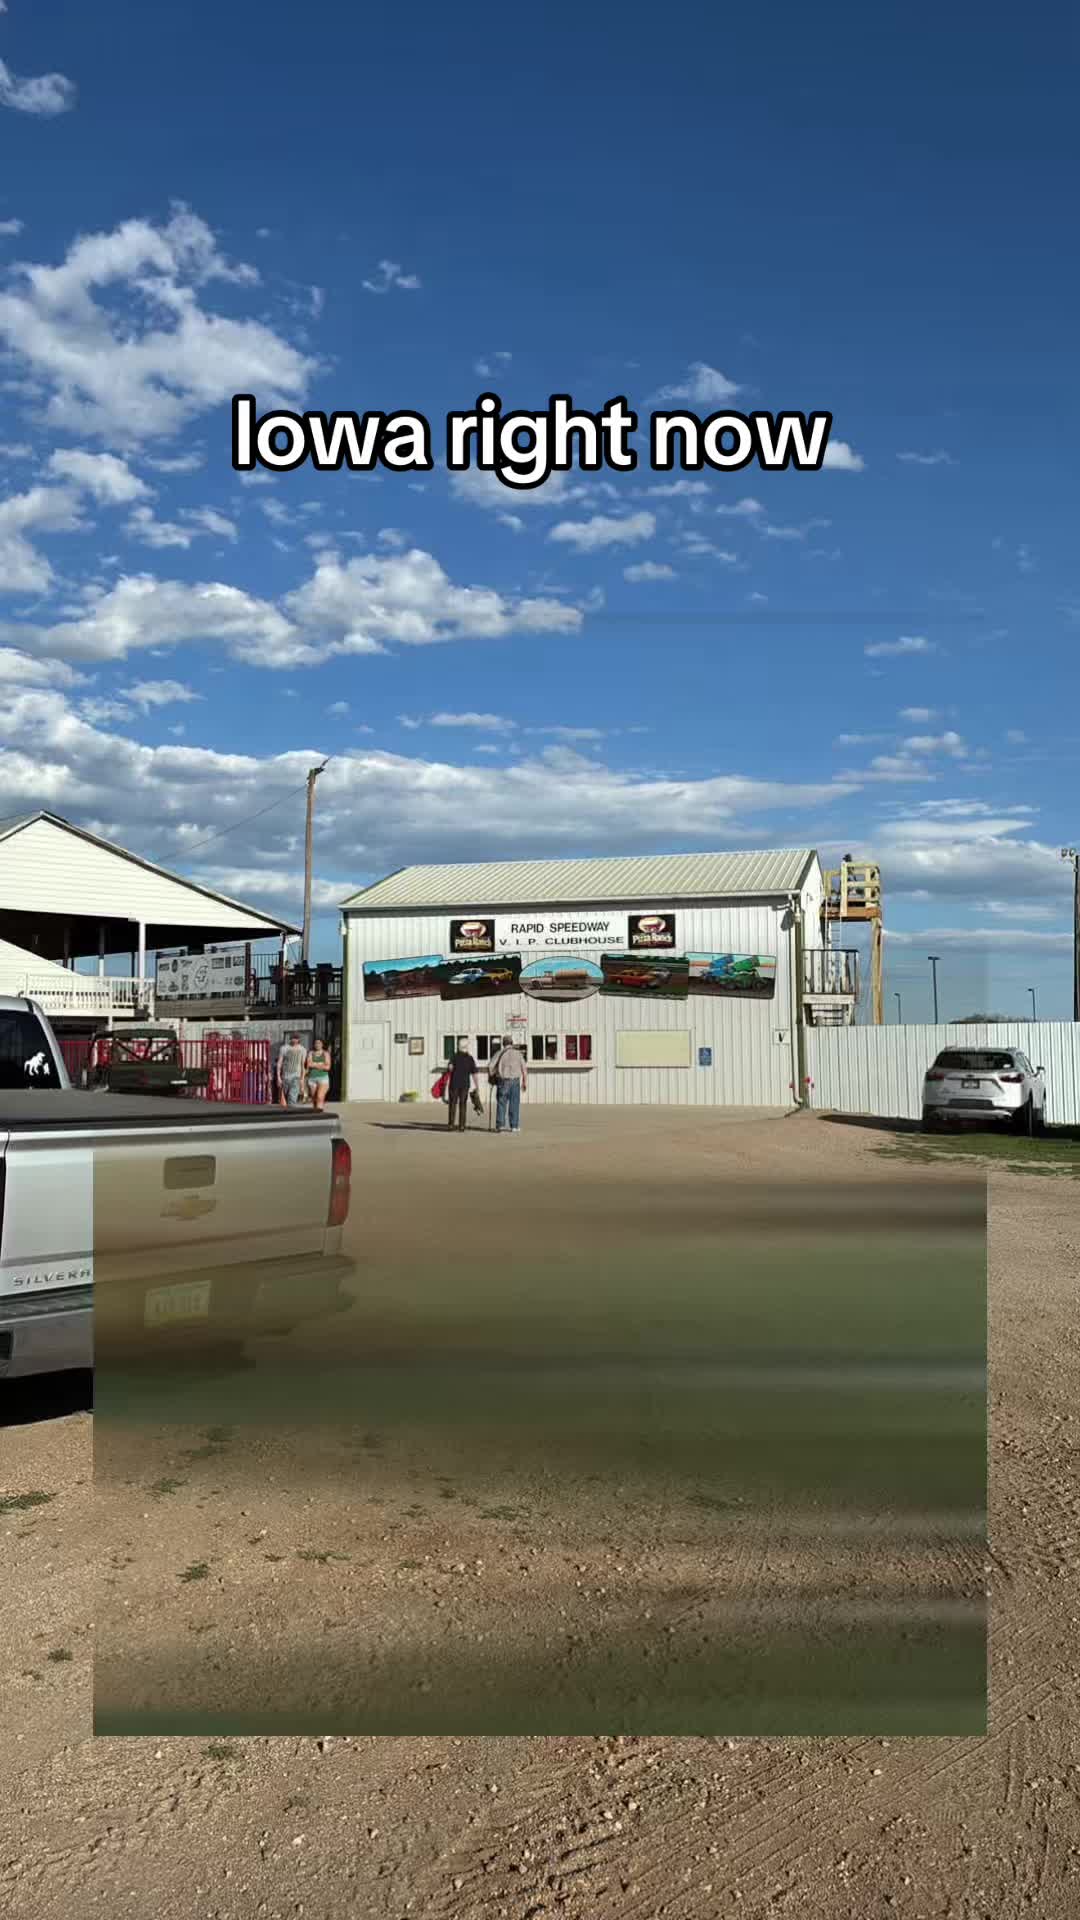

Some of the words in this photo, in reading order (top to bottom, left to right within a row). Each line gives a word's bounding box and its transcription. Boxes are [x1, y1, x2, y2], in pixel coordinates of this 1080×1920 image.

[511, 923, 544, 933] RAPID
[549, 921, 610, 932] SPEEDWAY
[545, 936, 624, 945] CLUBHOUSE
